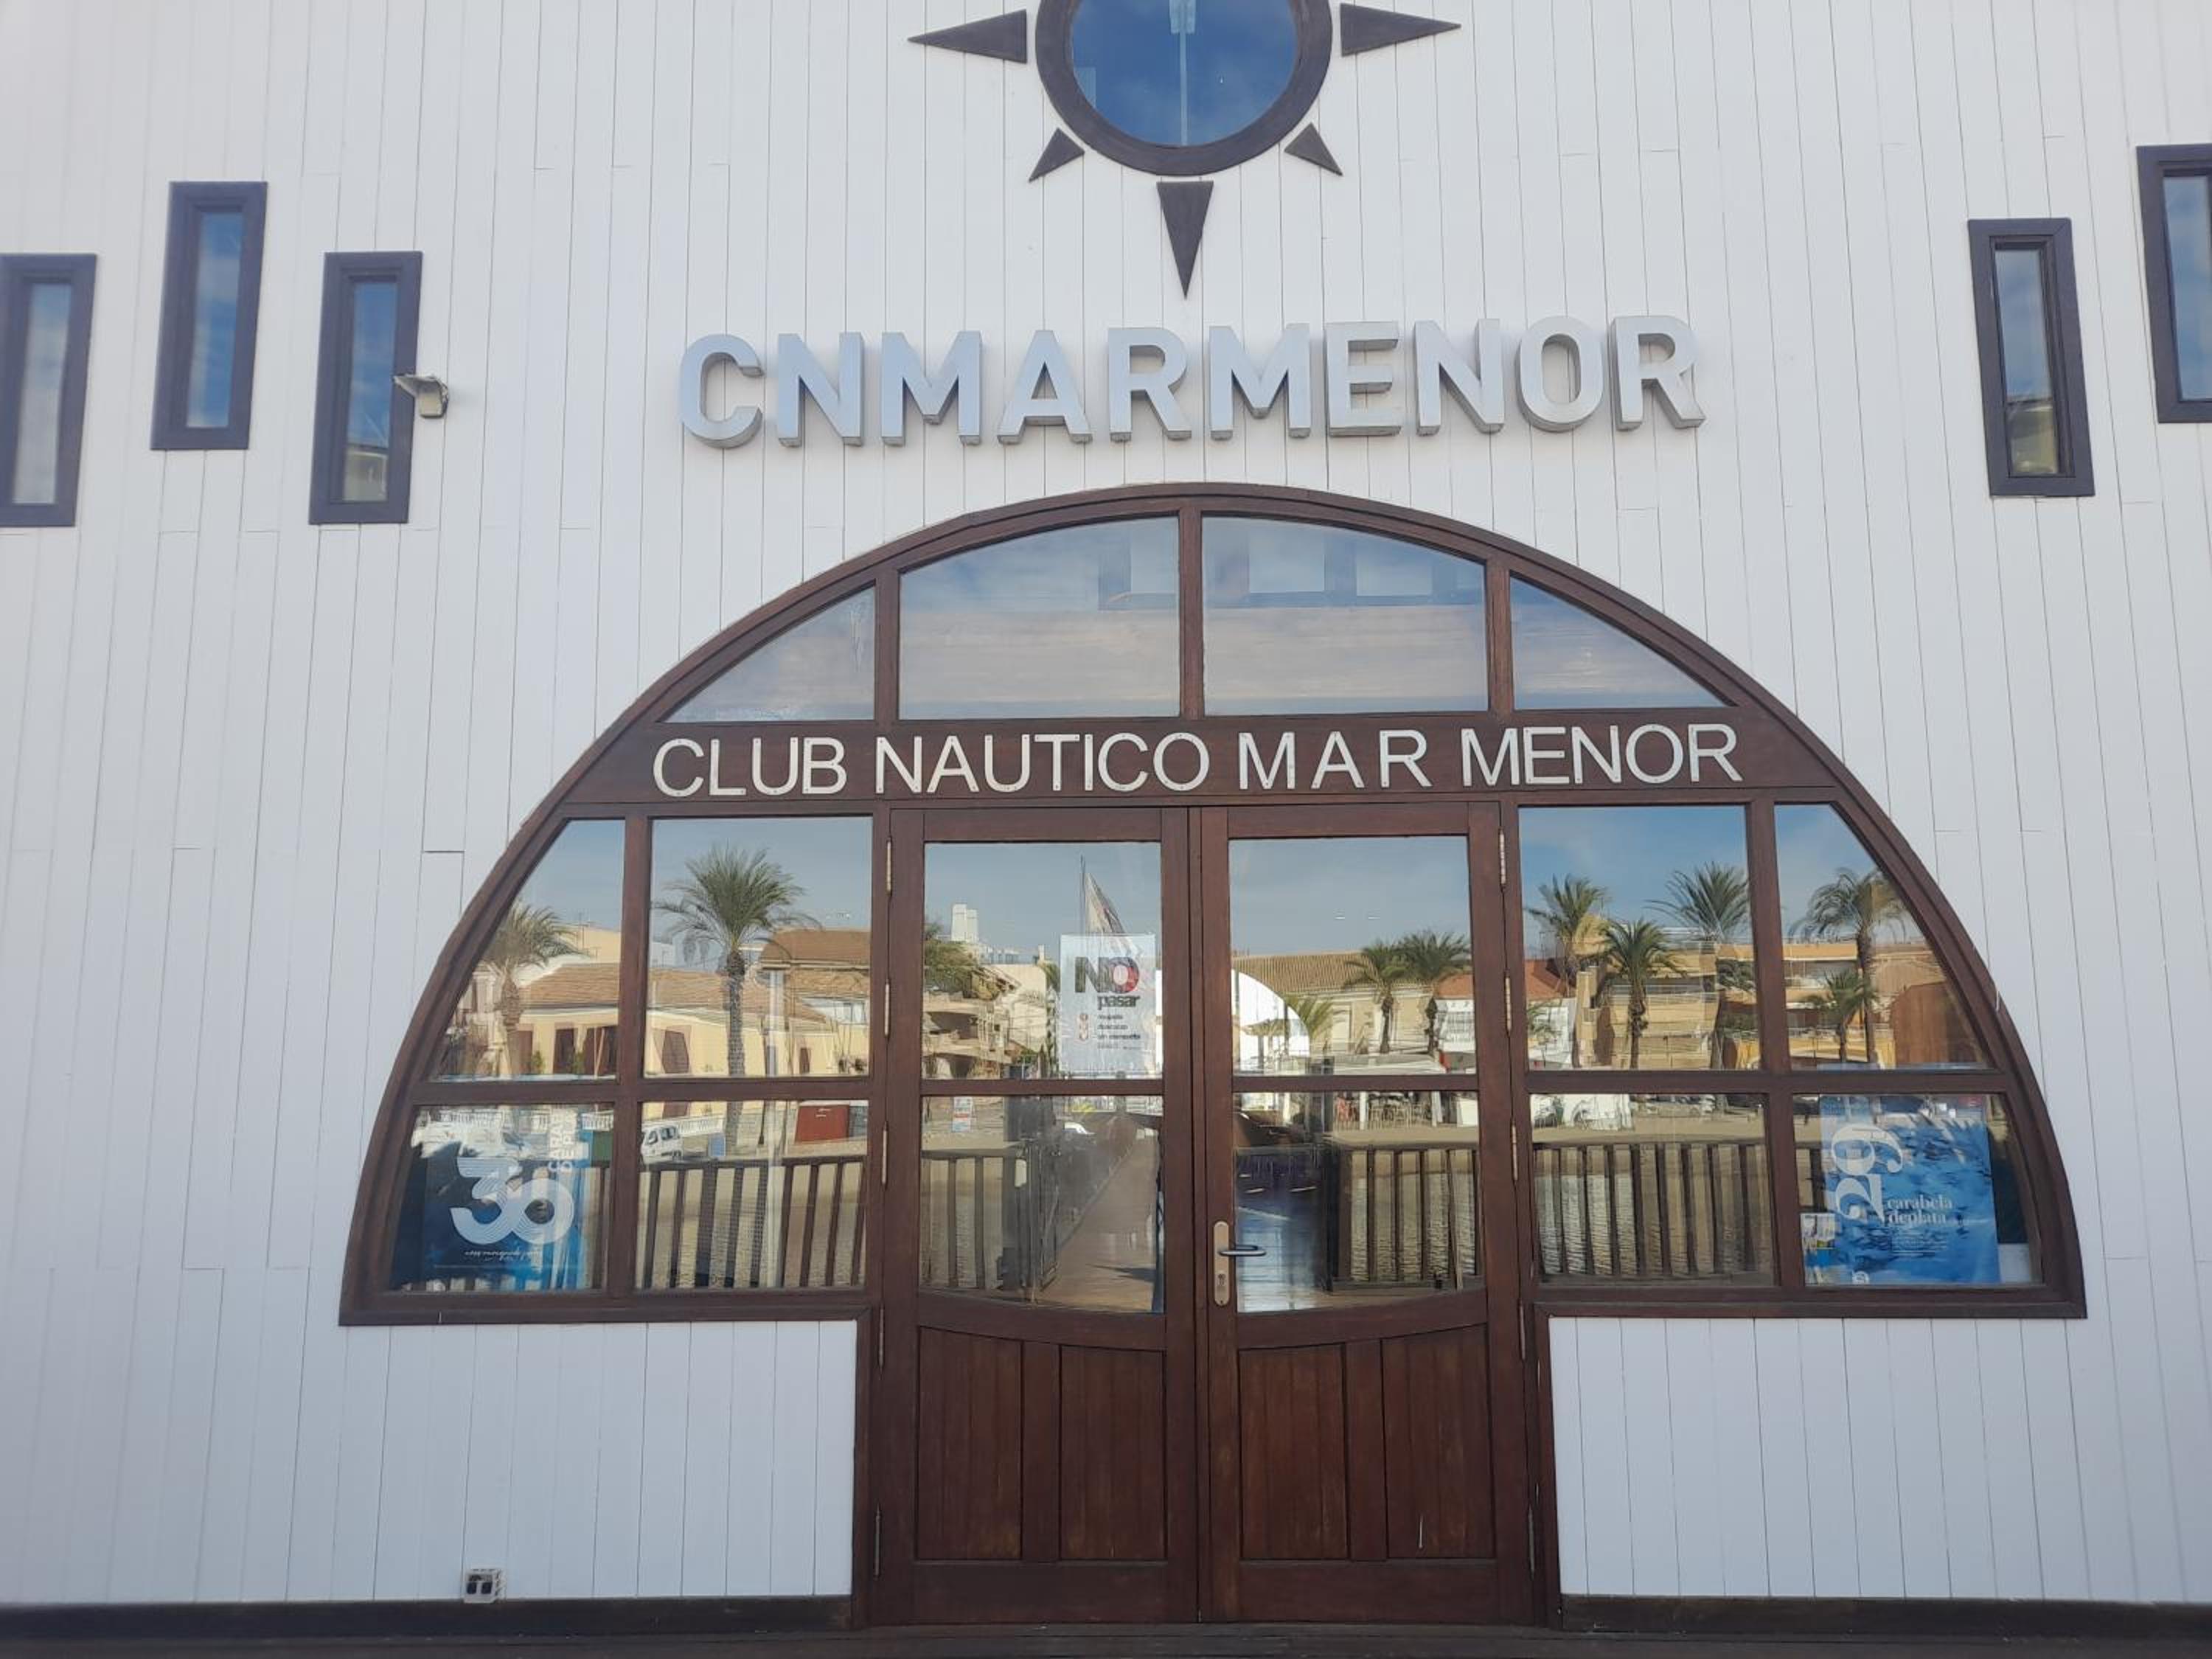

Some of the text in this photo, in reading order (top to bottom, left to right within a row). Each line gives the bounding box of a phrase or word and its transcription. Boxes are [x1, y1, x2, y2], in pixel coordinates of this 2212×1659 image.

[678, 315, 1705, 448] CNMARMENOR
[653, 724, 1742, 796] CLUB NAUTICO MAR MENOR
[1075, 957, 1139, 994] NO
[1097, 995, 1141, 1010] pasar
